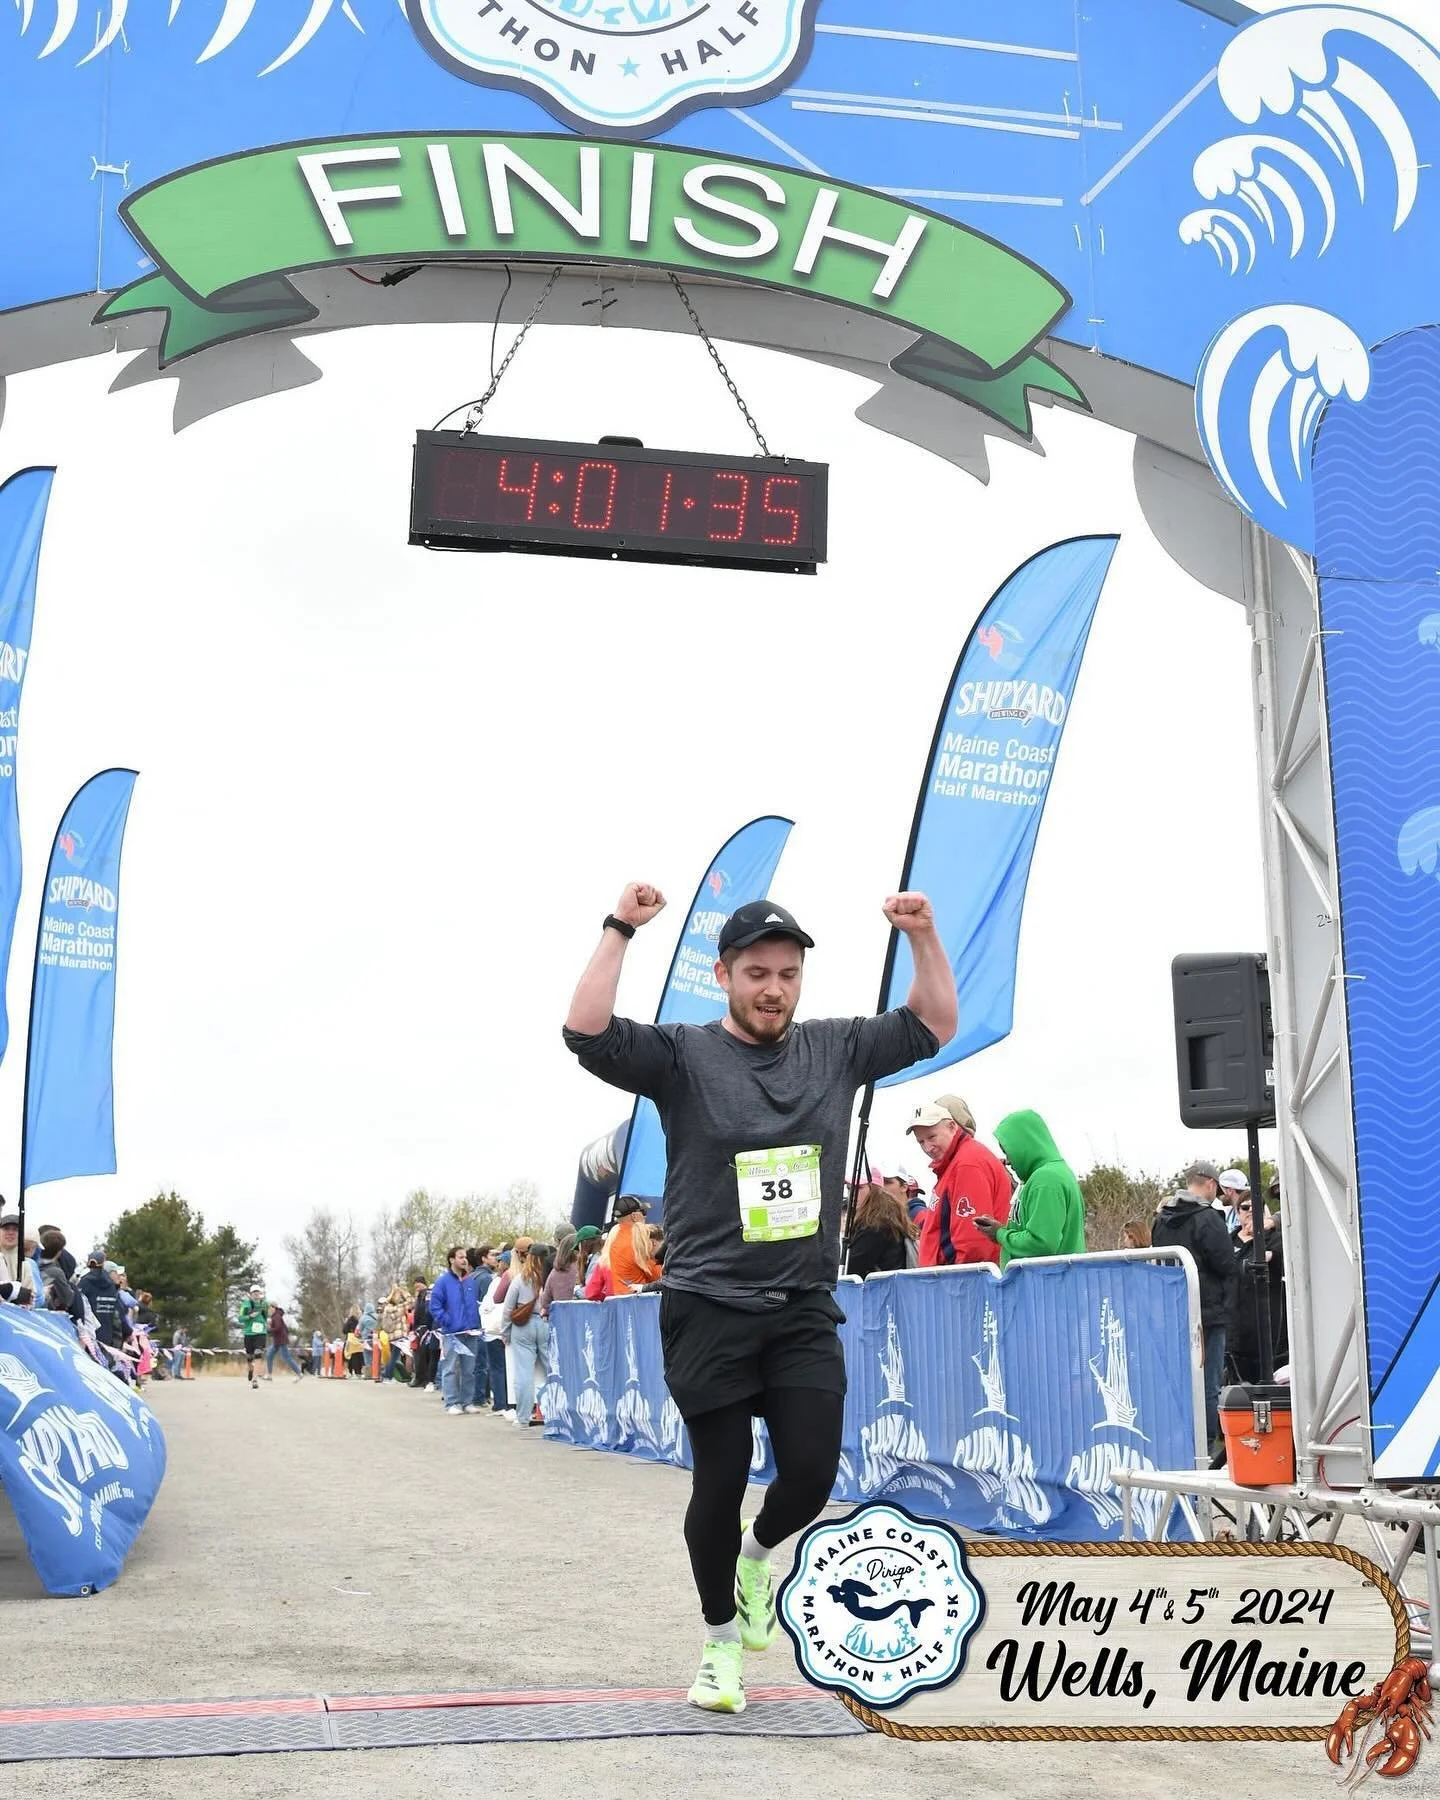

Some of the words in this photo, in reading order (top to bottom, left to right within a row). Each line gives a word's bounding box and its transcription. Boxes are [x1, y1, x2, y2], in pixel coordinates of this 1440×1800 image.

[661, 1, 760, 75] HALF
[297, 144, 929, 298] FINISH
[955, 680, 1067, 726] SHIPYARD
[943, 732, 999, 756] Maine
[1005, 739, 1056, 763] Coast
[937, 752, 1050, 789] Marathon
[933, 779, 967, 797] Half
[49, 876, 117, 912] SHIPYARD
[43, 916, 74, 935] Maine
[78, 921, 114, 939] Coast
[41, 932, 114, 957] Marathon
[679, 945, 713, 966] Maine
[39, 953, 58, 966] Half
[60, 955, 112, 971] Marathon
[671, 978, 690, 993] Half
[914, 1107, 922, 1119] N
[761, 1178, 793, 1201] 38
